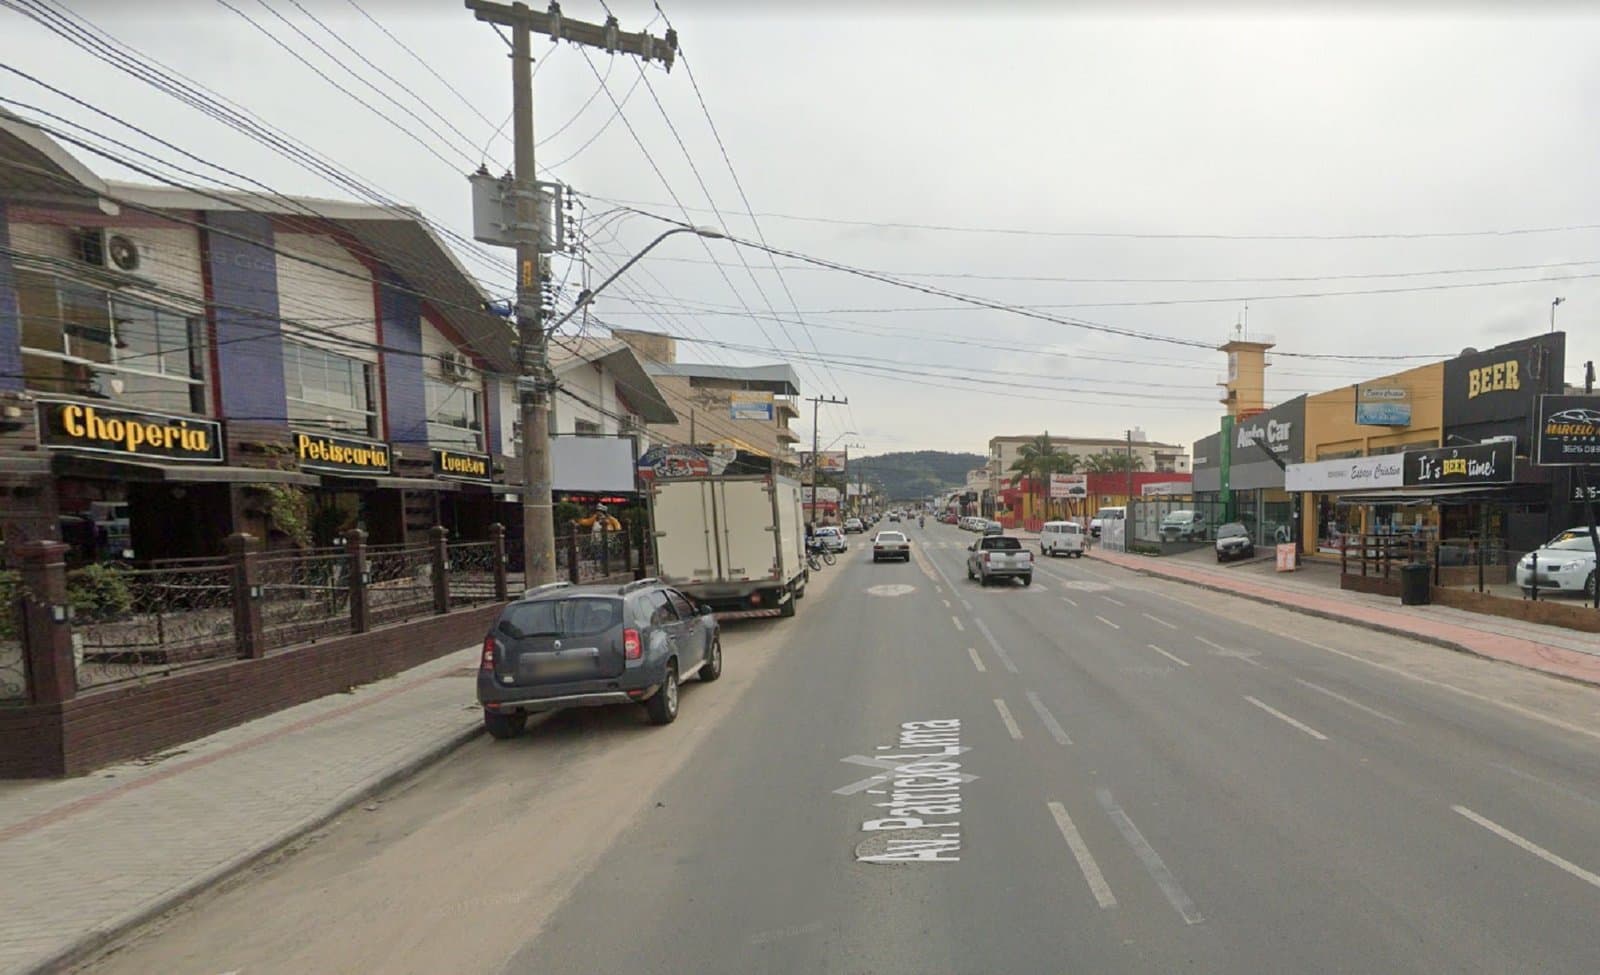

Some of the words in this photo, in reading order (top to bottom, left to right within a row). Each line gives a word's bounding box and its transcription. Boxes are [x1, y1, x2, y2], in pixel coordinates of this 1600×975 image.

[1468, 360, 1520, 400] BEER
[63, 405, 209, 452] Choperia
[1237, 424, 1265, 448] Auto
[1267, 420, 1292, 443] Car
[1545, 423, 1594, 435] MARCELO
[298, 434, 388, 467] Petiscaria
[441, 451, 485, 475] Eventos
[1443, 458, 1467, 477] BEER
[1467, 450, 1496, 477] time!
